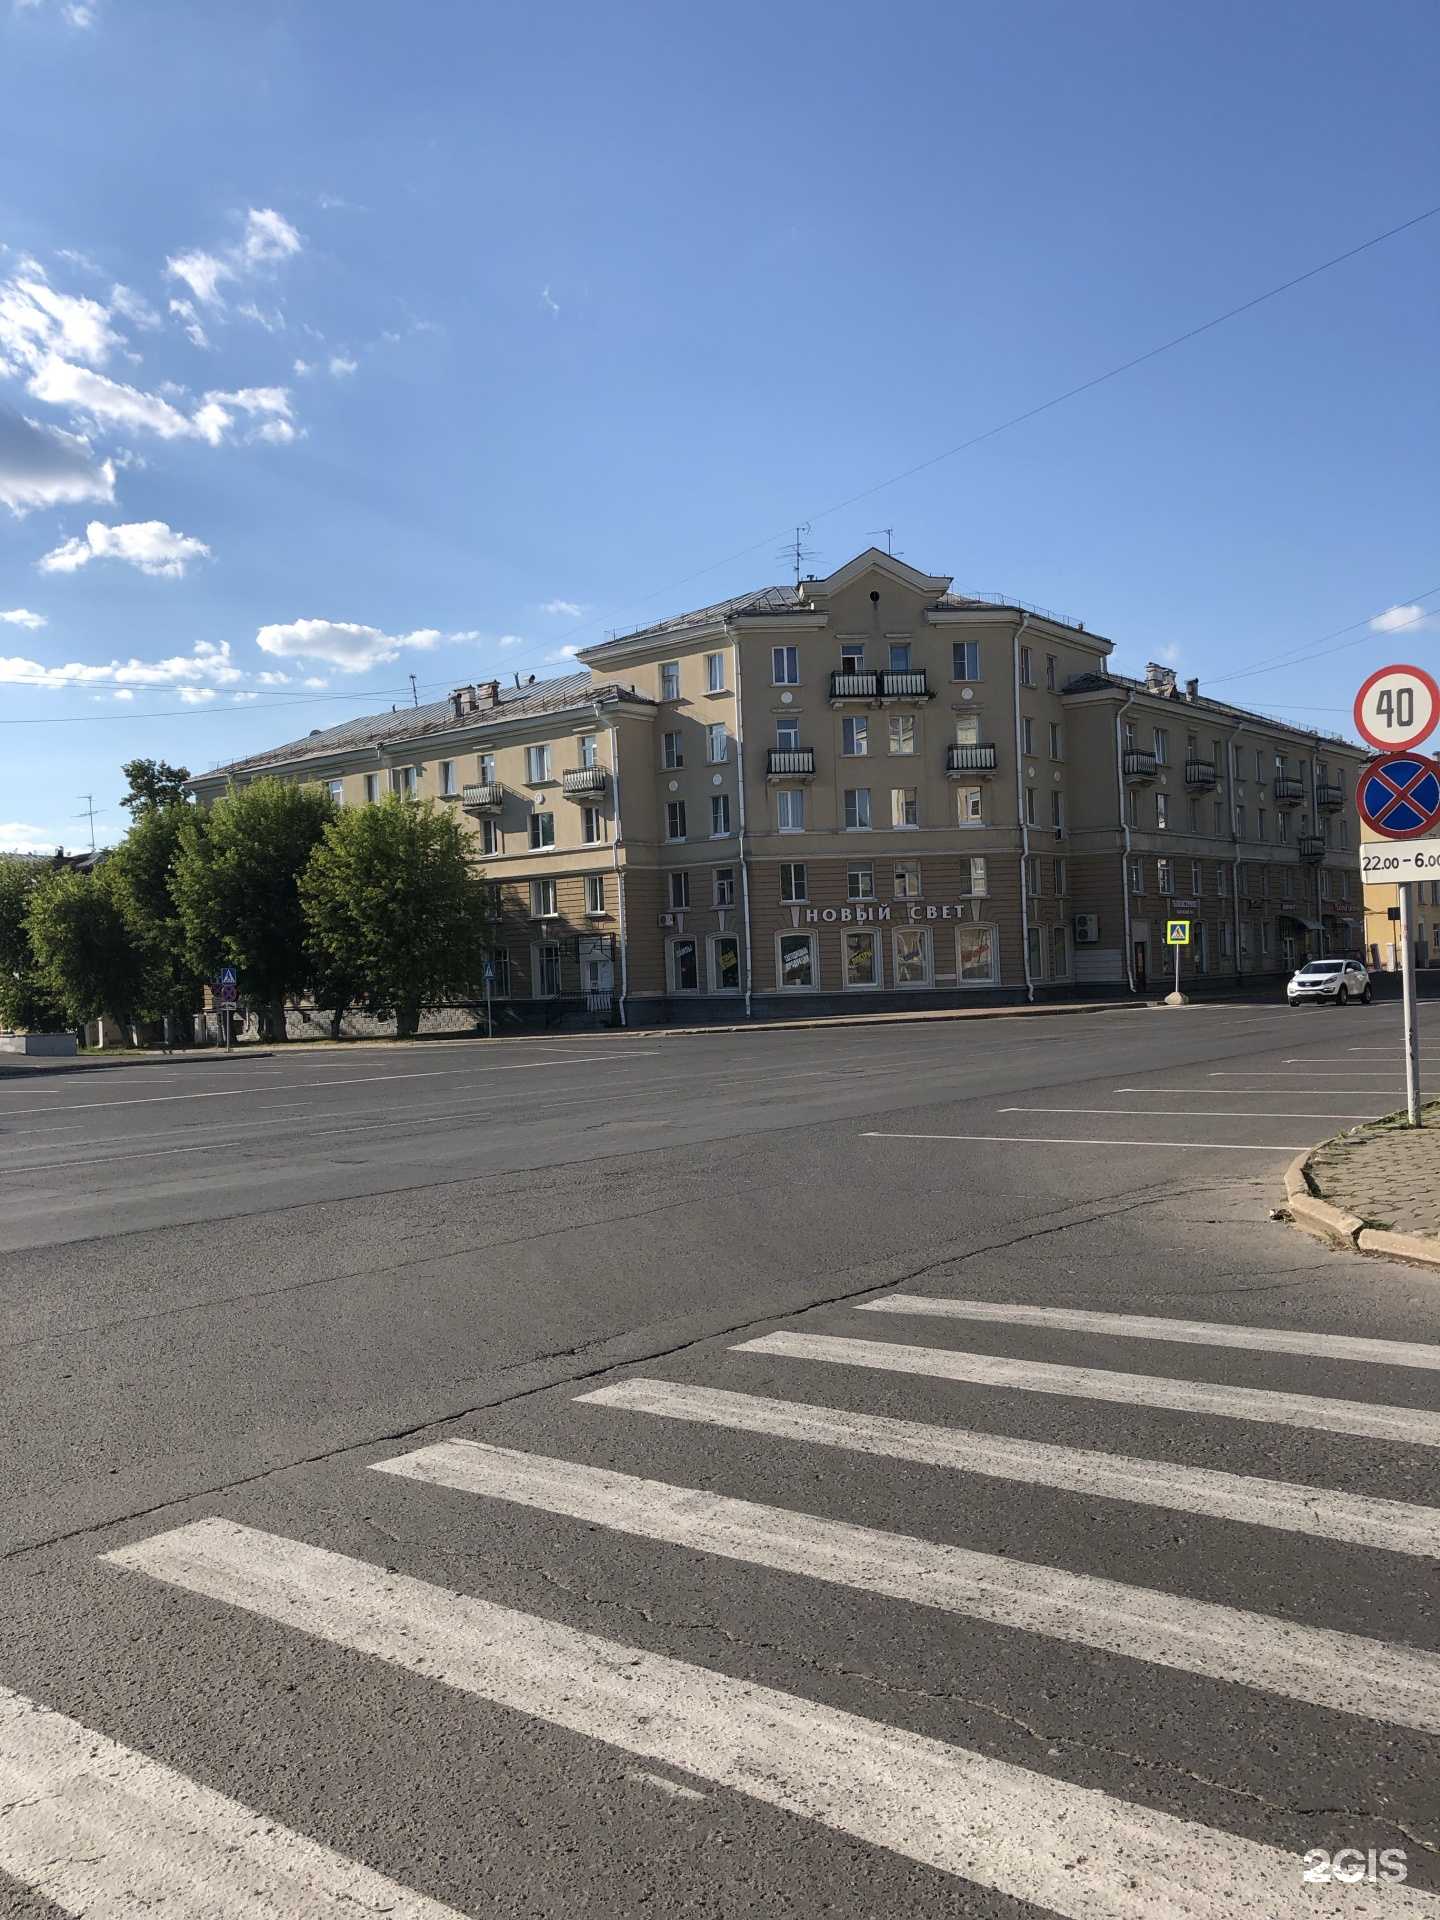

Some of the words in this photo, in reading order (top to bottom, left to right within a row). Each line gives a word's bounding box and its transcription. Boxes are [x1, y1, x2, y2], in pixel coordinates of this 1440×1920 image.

[1376, 687, 1414, 728] 40
[1362, 855, 1400, 871] 22.00
[806, 904, 891, 922] НОВЫЙ
[910, 904, 965, 920] СВЕТ
